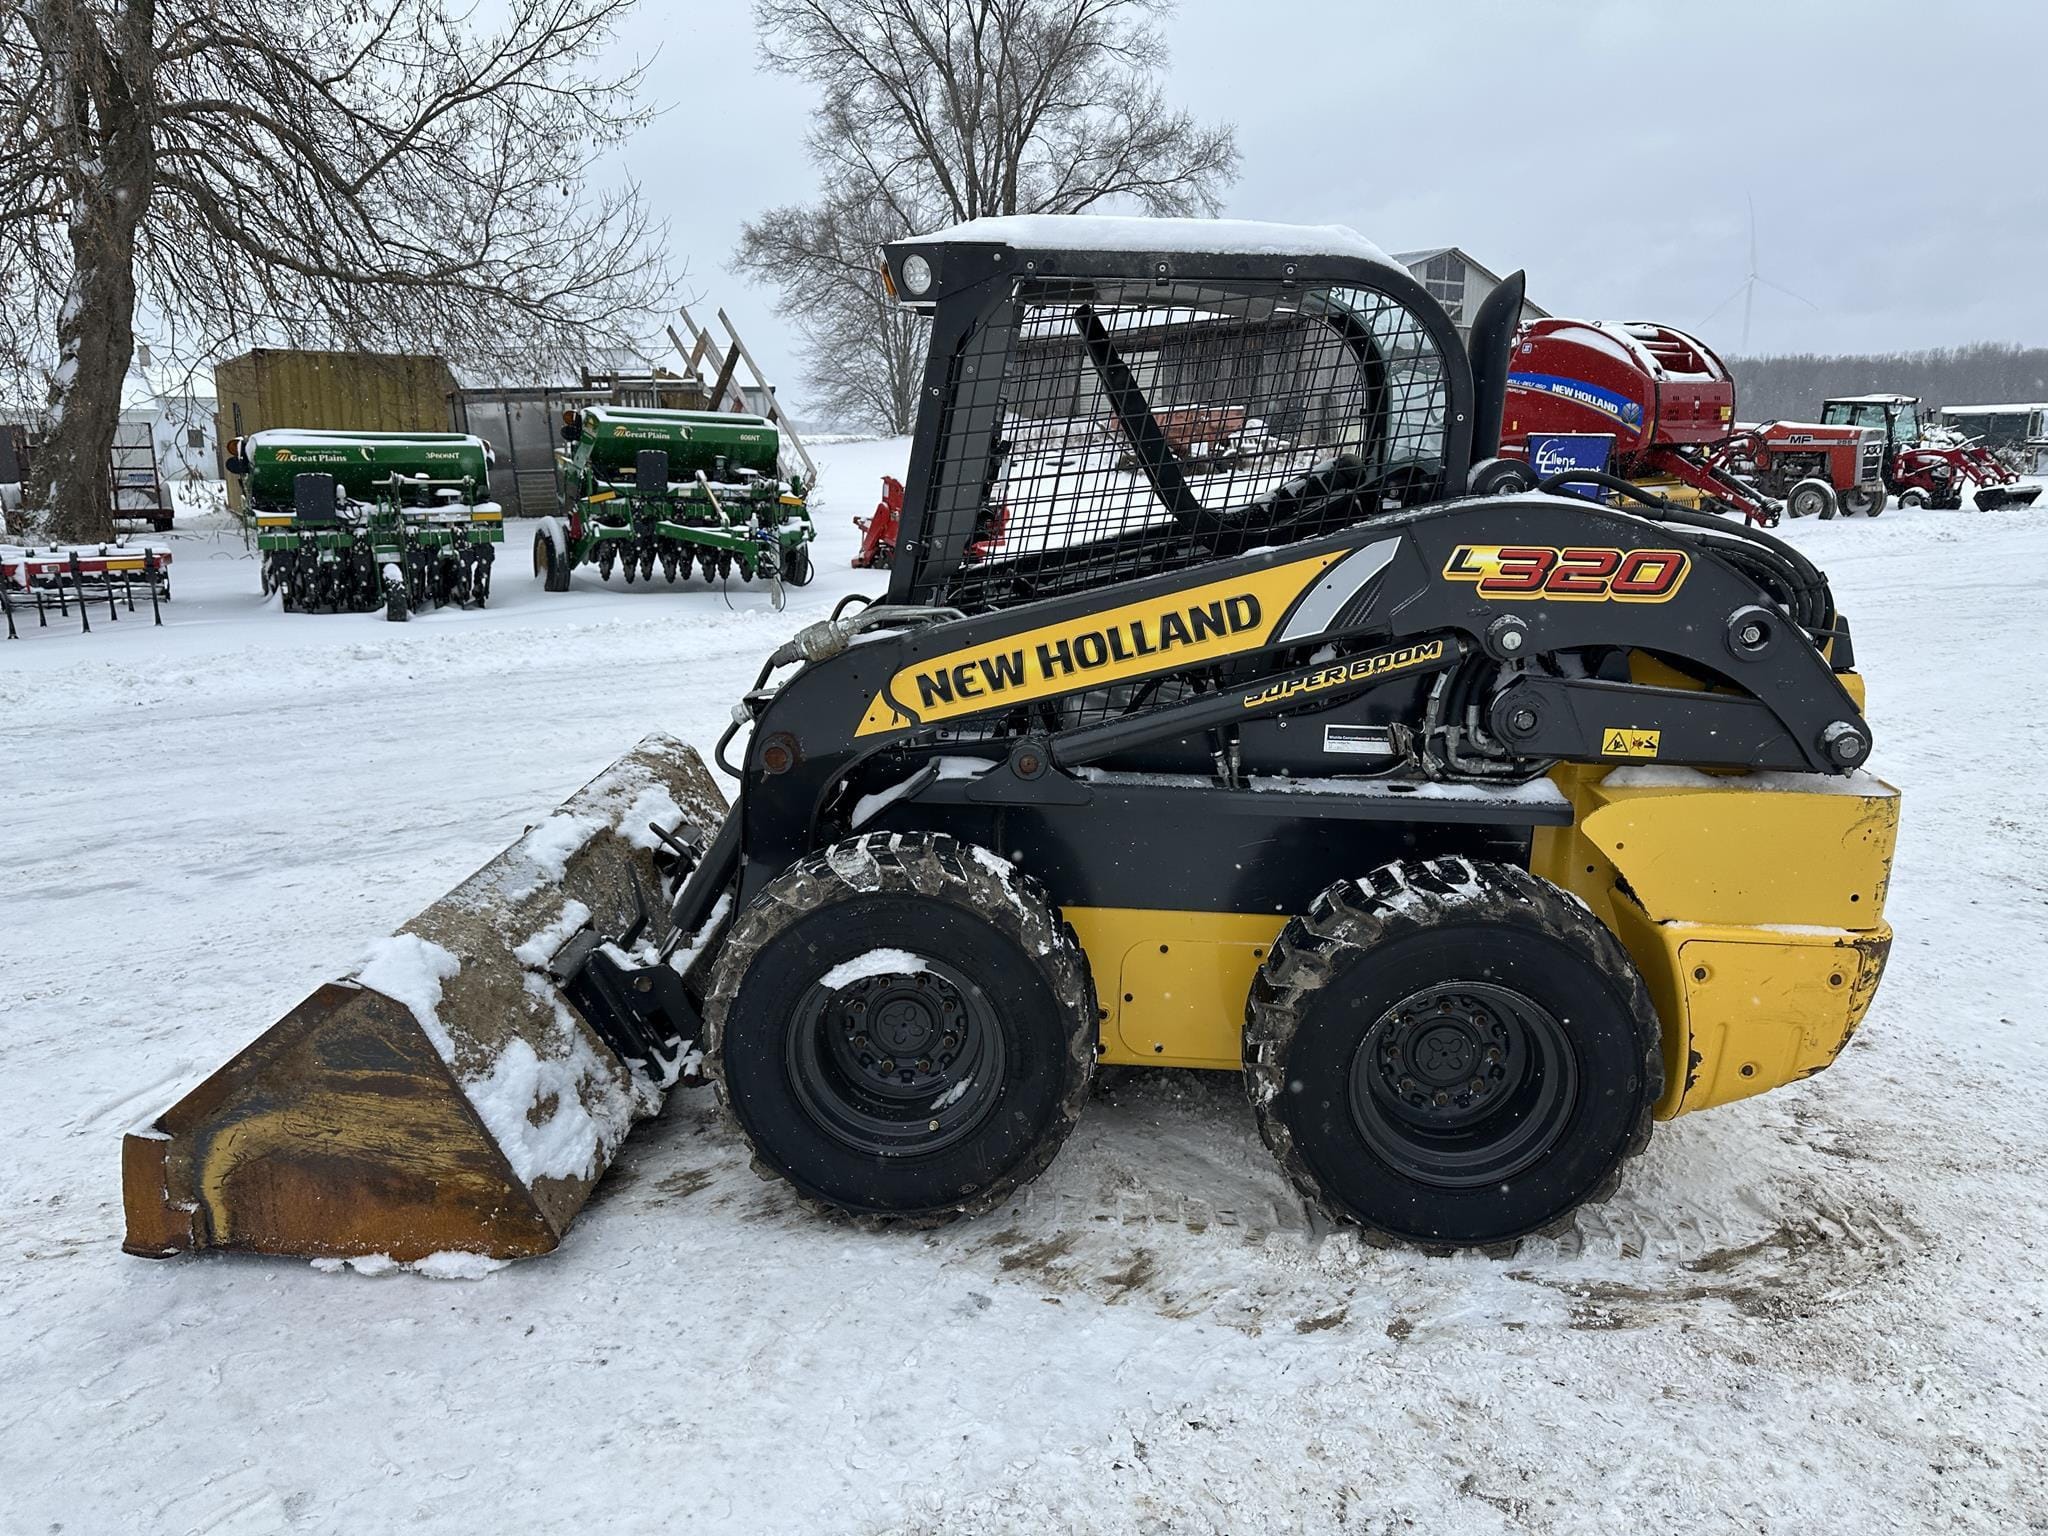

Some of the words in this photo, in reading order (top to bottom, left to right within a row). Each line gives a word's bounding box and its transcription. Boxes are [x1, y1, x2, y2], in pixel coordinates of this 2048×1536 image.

[1552, 383, 1574, 397] NEW
[1575, 390, 1618, 414] HOLLAND
[625, 431, 646, 439] Great
[648, 432, 671, 440] Plains
[290, 454, 317, 462] Great
[319, 454, 347, 462] Plains
[1443, 545, 1692, 603] L320
[915, 649, 1025, 708] NEW
[1035, 593, 1263, 680] HOLLAND
[1244, 666, 1347, 708] SUPER
[1350, 640, 1443, 680] BOOM
